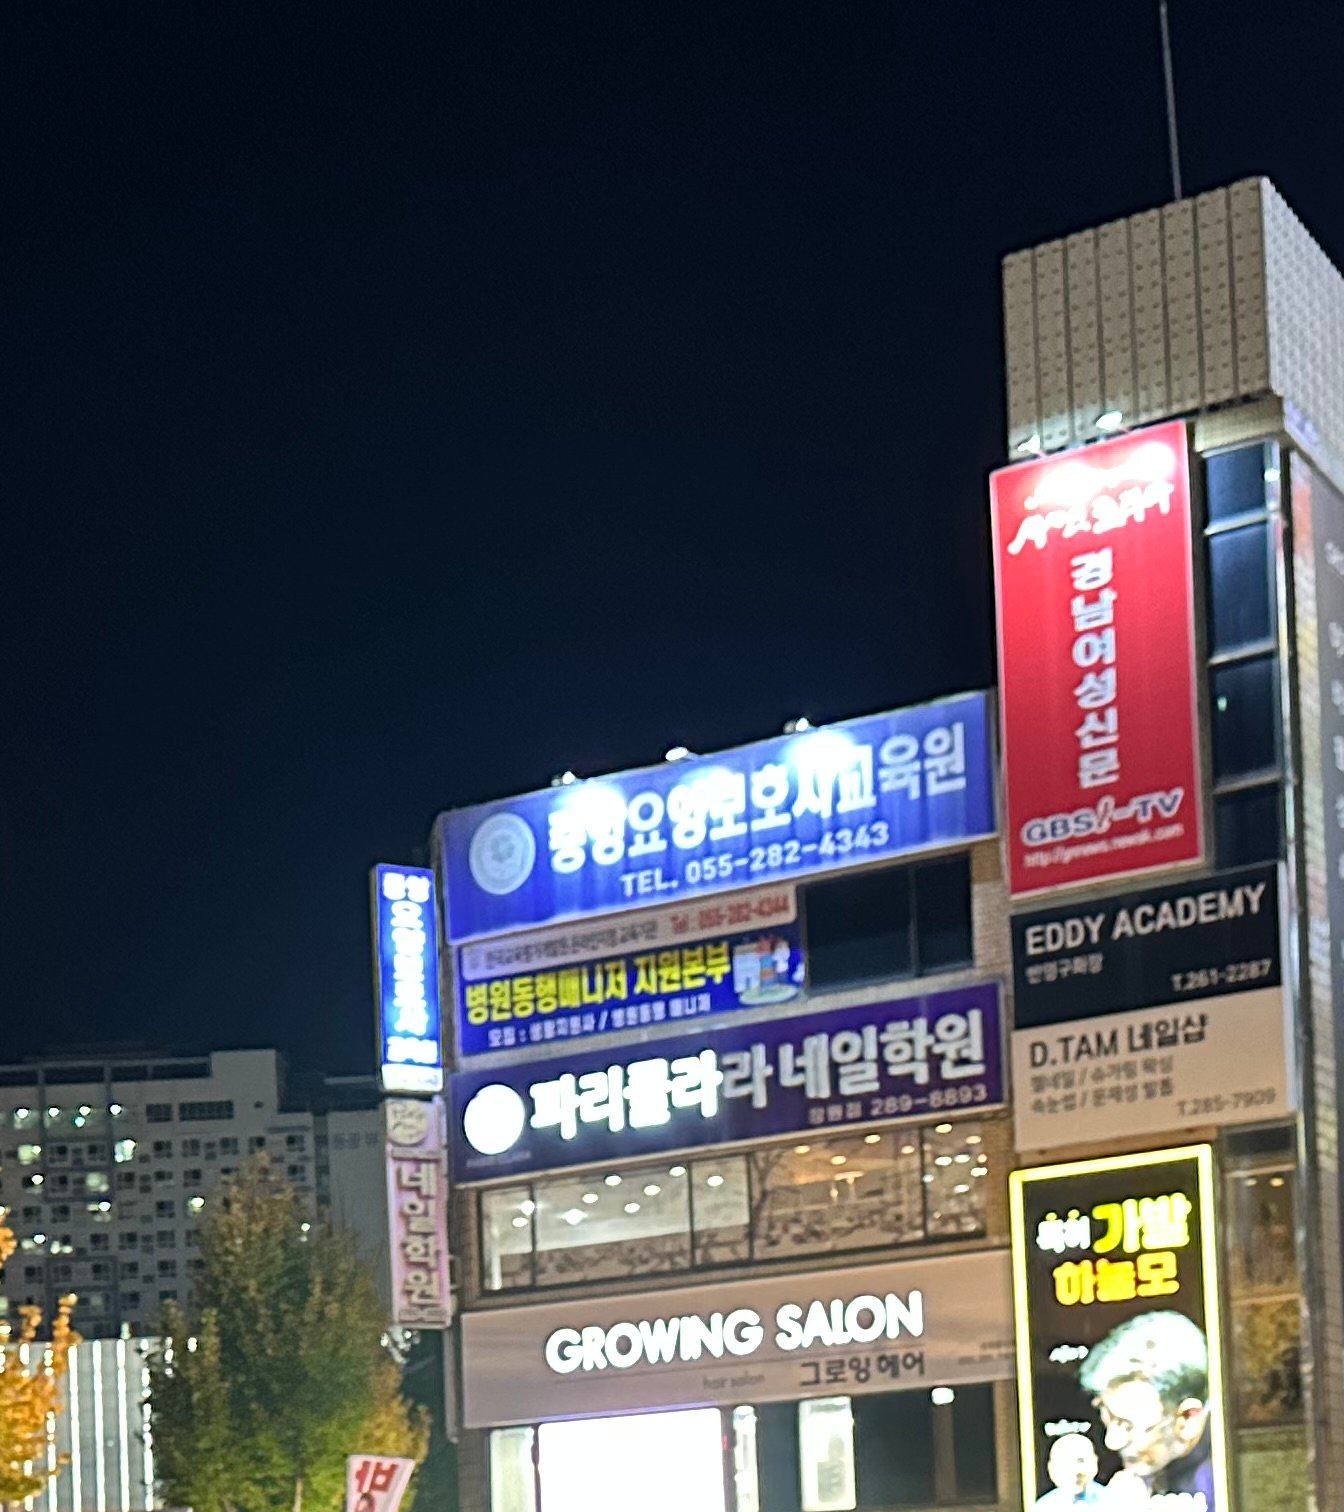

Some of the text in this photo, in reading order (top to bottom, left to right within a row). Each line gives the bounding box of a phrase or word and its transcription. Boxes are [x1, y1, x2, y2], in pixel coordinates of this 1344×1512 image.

[620, 822, 890, 897] TEL. 055-282-4343
[1025, 882, 1267, 956] EDDY ACADEMY
[778, 1008, 986, 1099] 네일학원
[1029, 1028, 1119, 1069] D.TAM
[1092, 1192, 1192, 1254] 가발
[1052, 1251, 1181, 1306] 하늘모
[544, 1290, 925, 1375] GROWING SALON
